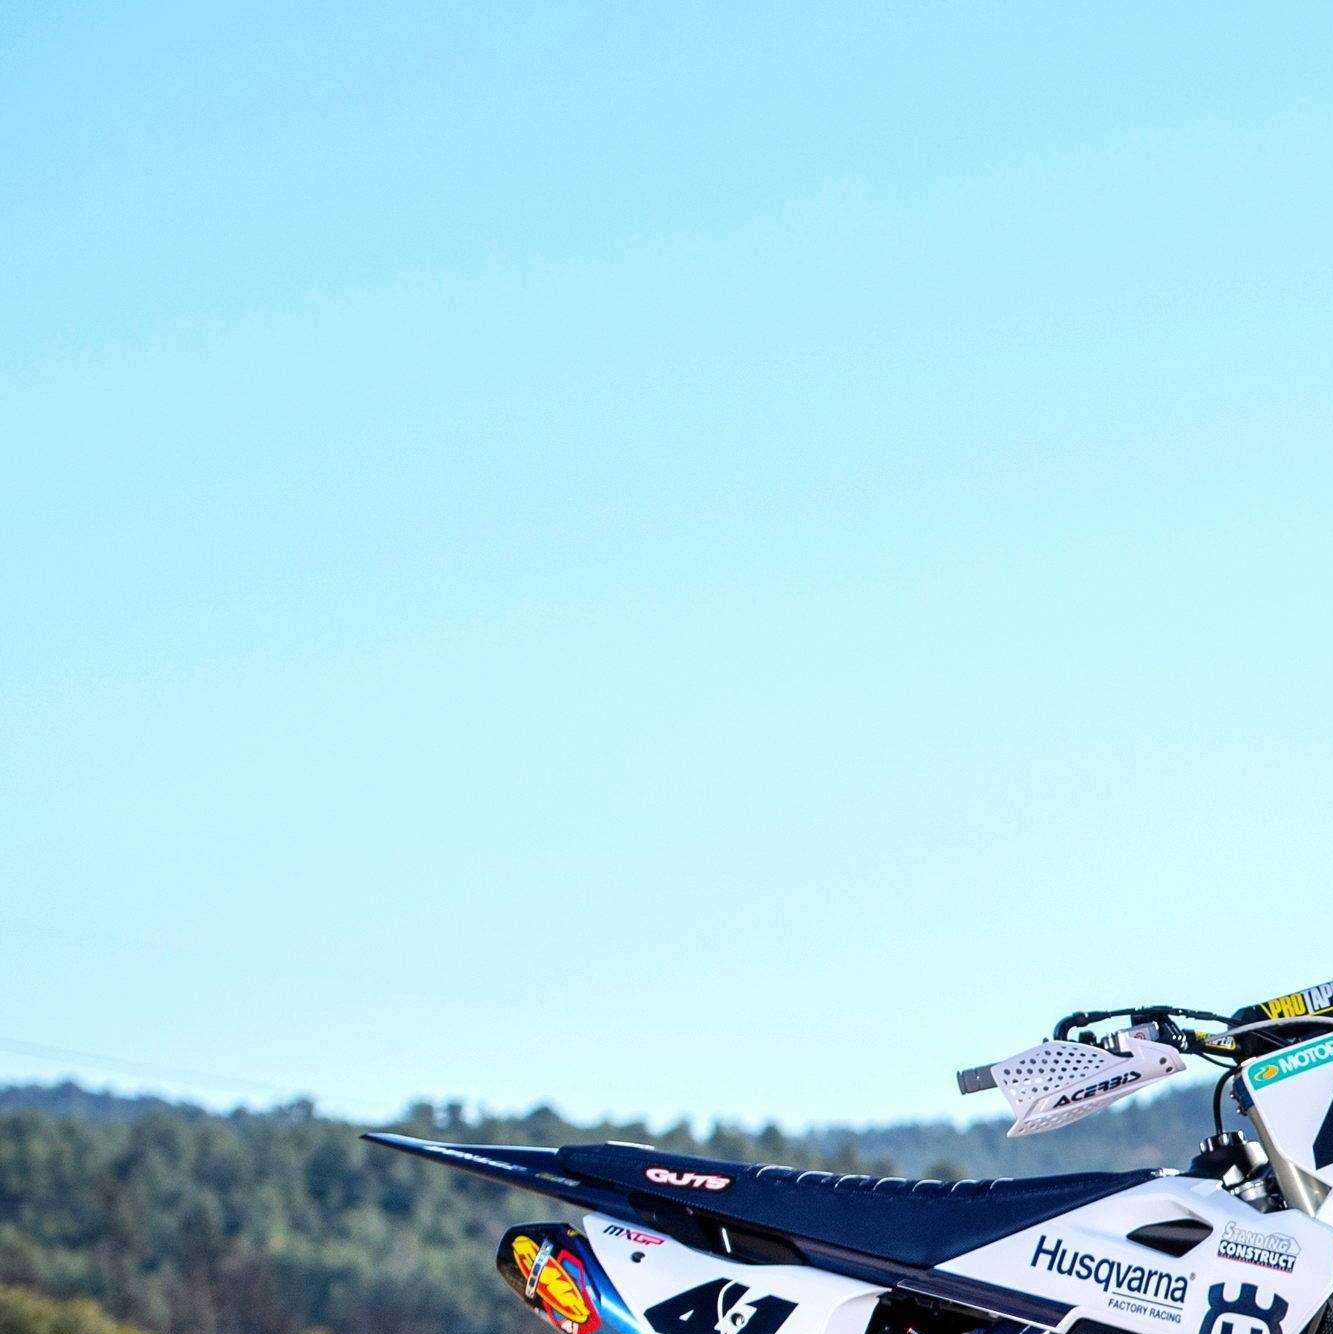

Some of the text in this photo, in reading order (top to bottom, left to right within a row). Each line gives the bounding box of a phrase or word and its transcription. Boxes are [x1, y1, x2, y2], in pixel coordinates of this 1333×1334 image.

[1053, 1071, 1142, 1108] ACERBIS
[645, 1168, 731, 1190] GUTS
[603, 1225, 665, 1246] MXGP
[1221, 1221, 1292, 1254] STANDING
[1219, 1241, 1296, 1268] CONSTRUCT
[1031, 1235, 1190, 1303] Husqvarna
[1108, 1298, 1181, 1324] FACTORY RACING
